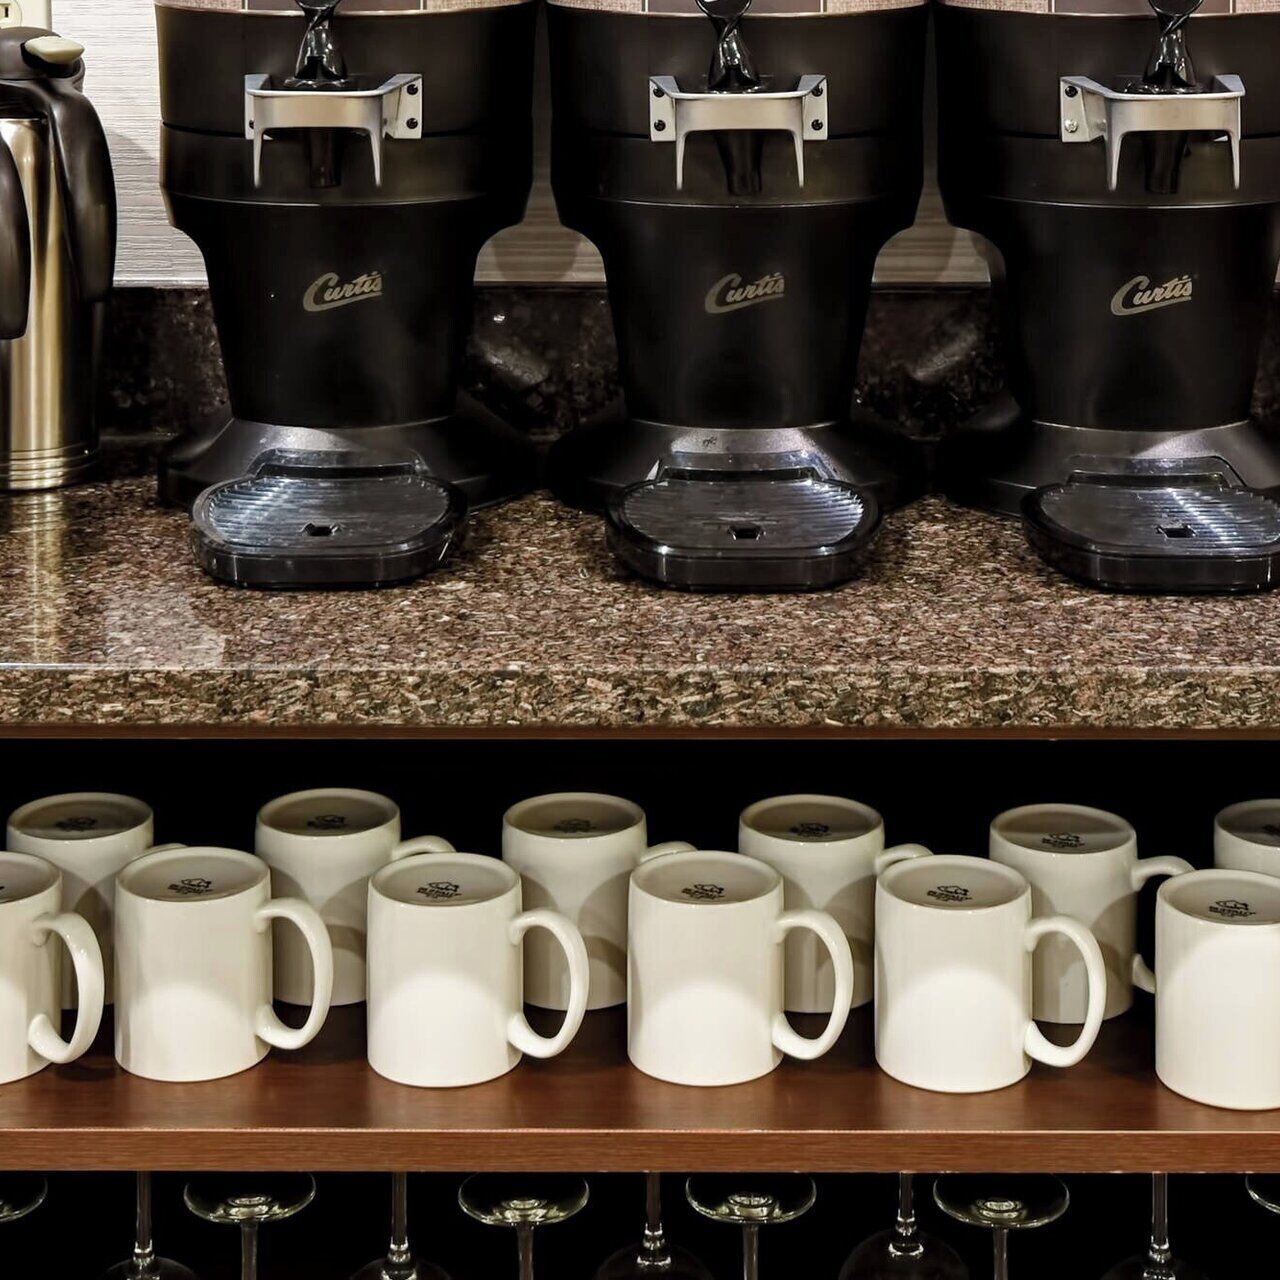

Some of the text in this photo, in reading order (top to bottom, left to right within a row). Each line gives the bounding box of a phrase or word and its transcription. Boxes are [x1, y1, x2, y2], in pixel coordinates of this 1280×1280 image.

[303, 271, 382, 312] Curtis
[705, 272, 785, 314] Curtis
[1111, 275, 1192, 316] Curtis
